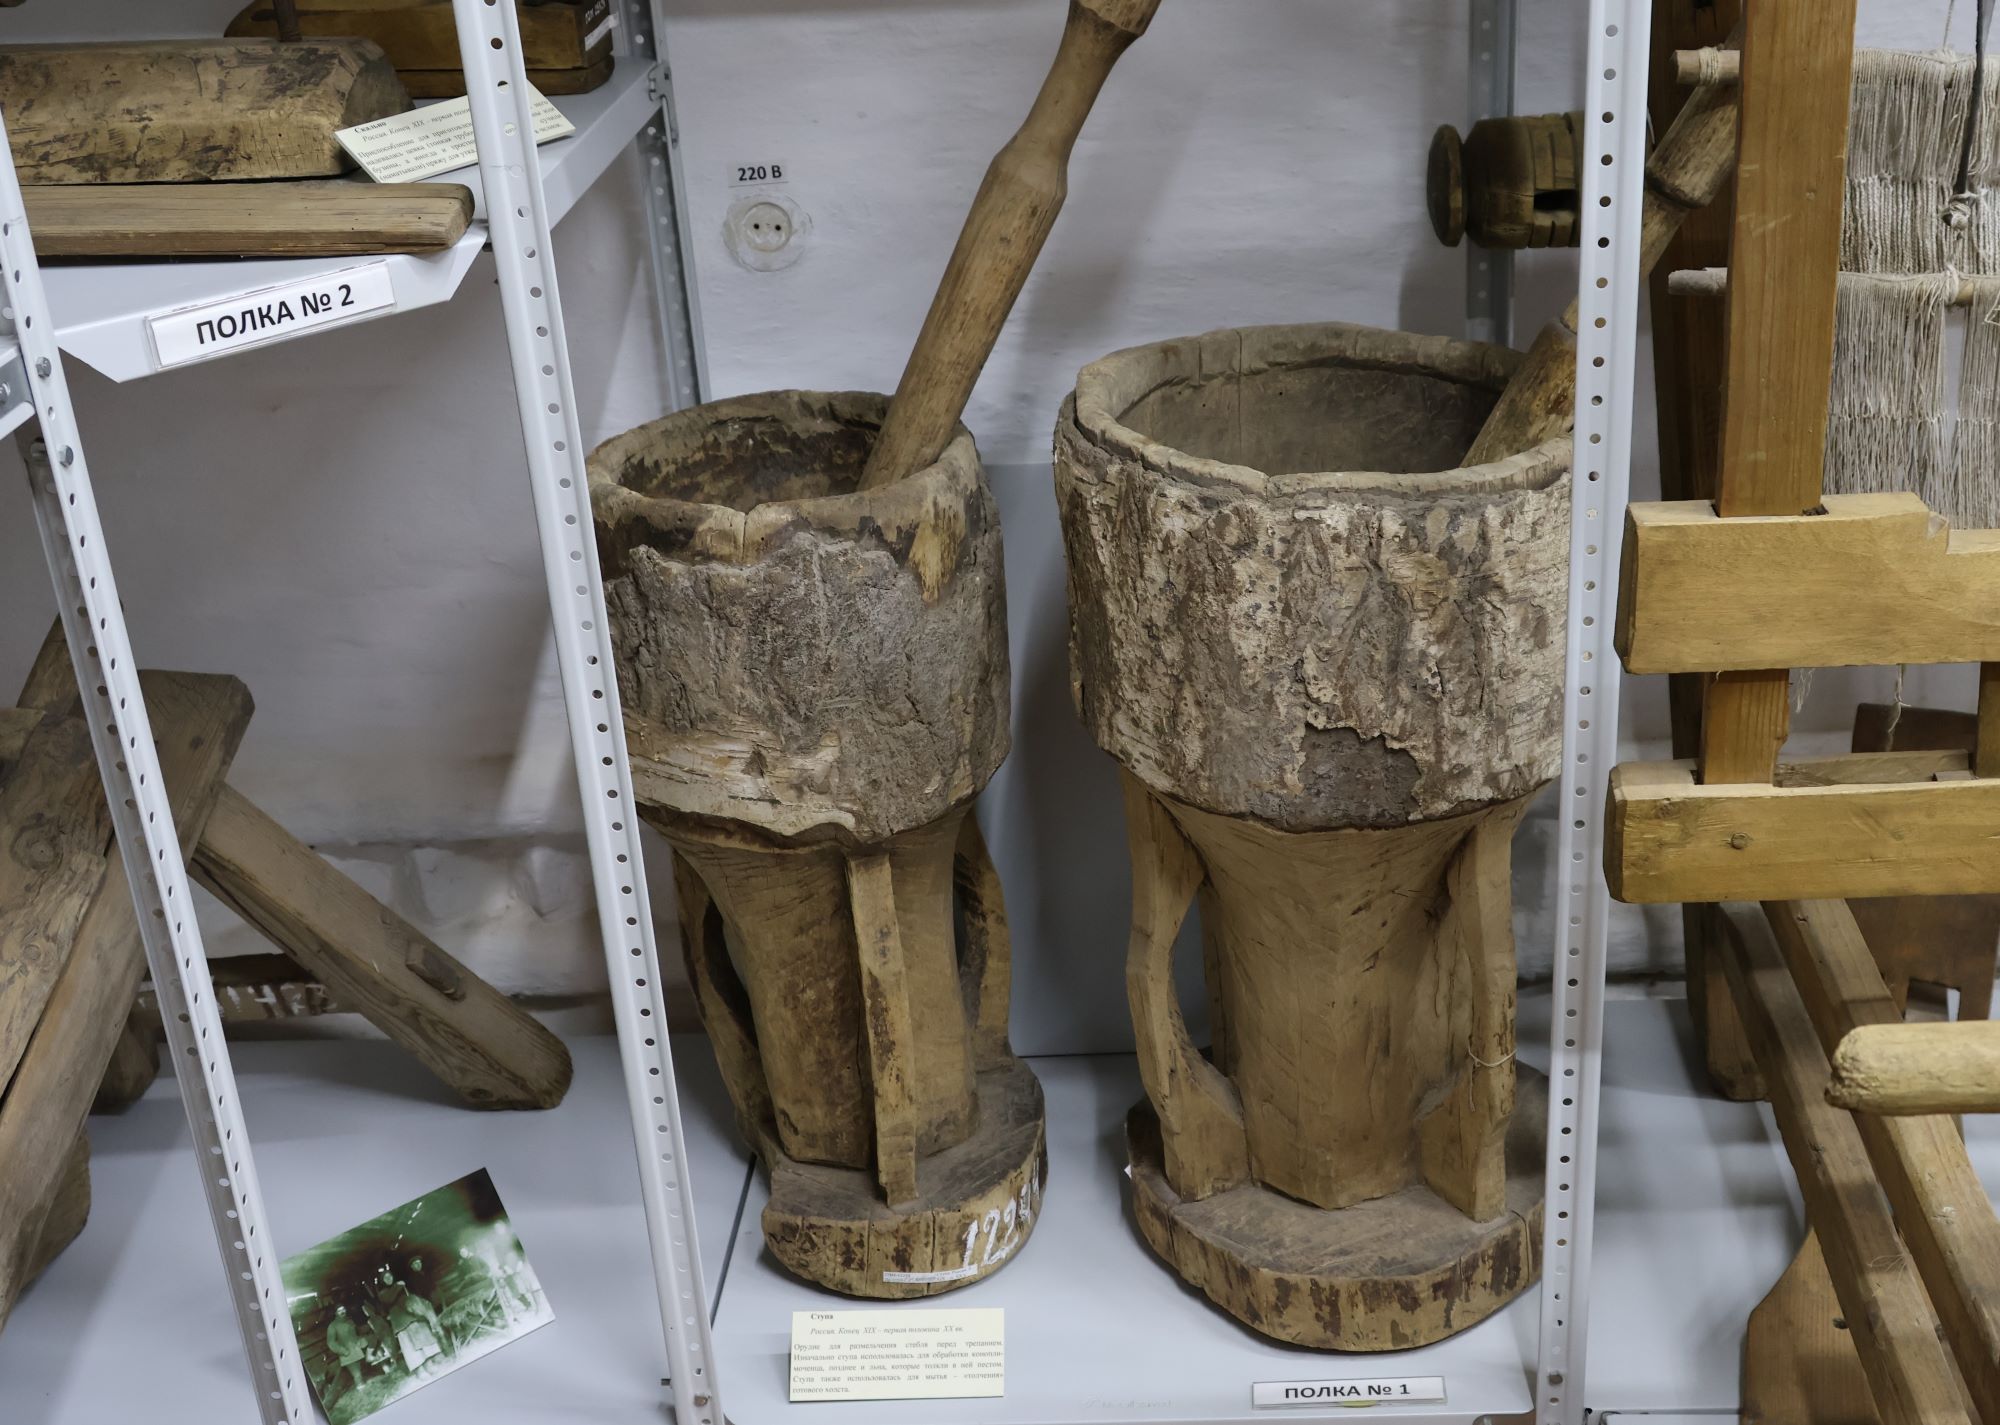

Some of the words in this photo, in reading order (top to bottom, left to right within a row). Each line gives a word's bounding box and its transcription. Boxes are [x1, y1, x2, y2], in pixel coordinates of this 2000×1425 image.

[389, 125, 410, 134] Конец
[412, 120, 425, 128] XIX
[432, 123, 472, 137] приготовлен
[738, 166, 766, 181] 220
[771, 165, 782, 178] В
[196, 300, 295, 345] ПОЛКА
[301, 292, 332, 317] №
[338, 284, 354, 306] 2
[811, 1313, 834, 1321] Ступа
[838, 1327, 860, 1335] Конец
[932, 1351, 968, 1359] обработки
[793, 1376, 814, 1384] Ступа
[1285, 1386, 1361, 1398] ПОЛКА
[1368, 1385, 1392, 1395] №
[1400, 1384, 1410, 1395] 1
